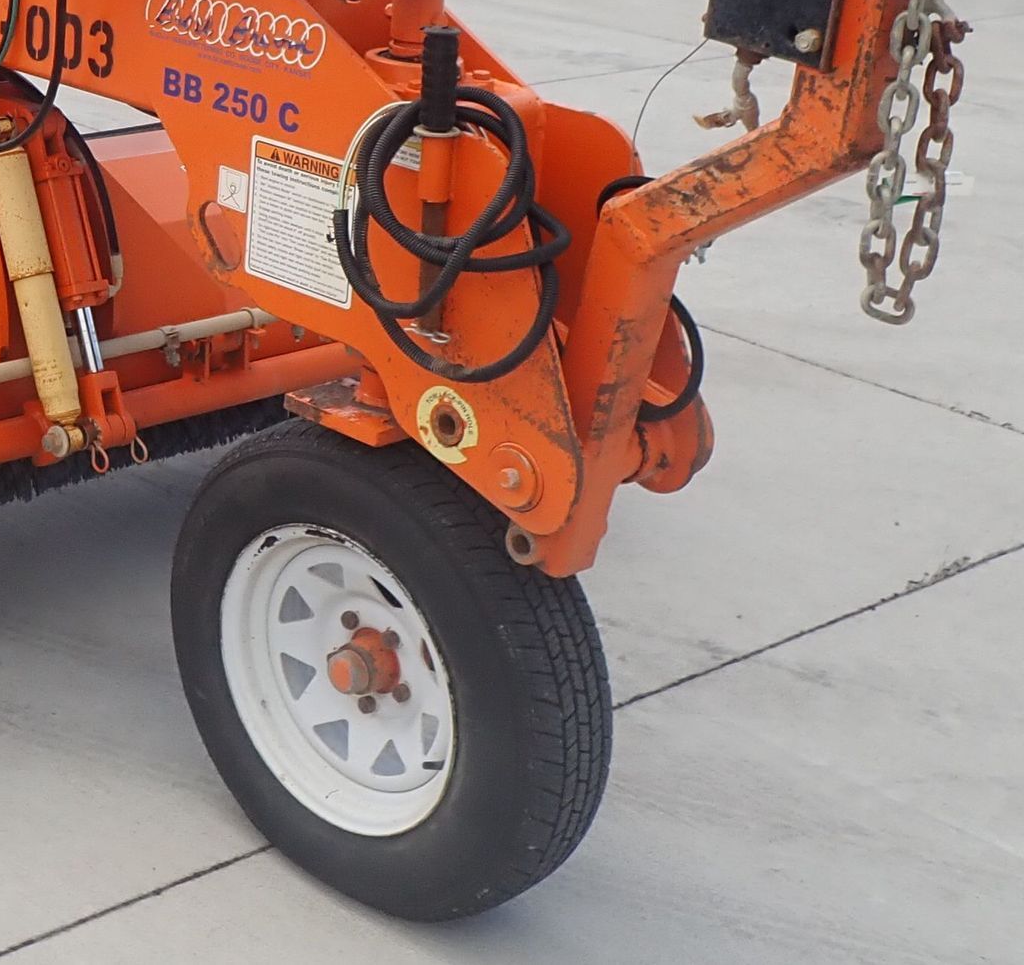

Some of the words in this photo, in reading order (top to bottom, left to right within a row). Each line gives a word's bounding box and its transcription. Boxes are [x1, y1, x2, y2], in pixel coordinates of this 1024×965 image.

[163, 67, 202, 103] BB
[212, 82, 267, 123] 250
[279, 102, 299, 132] C
[283, 151, 340, 179] WARNING
